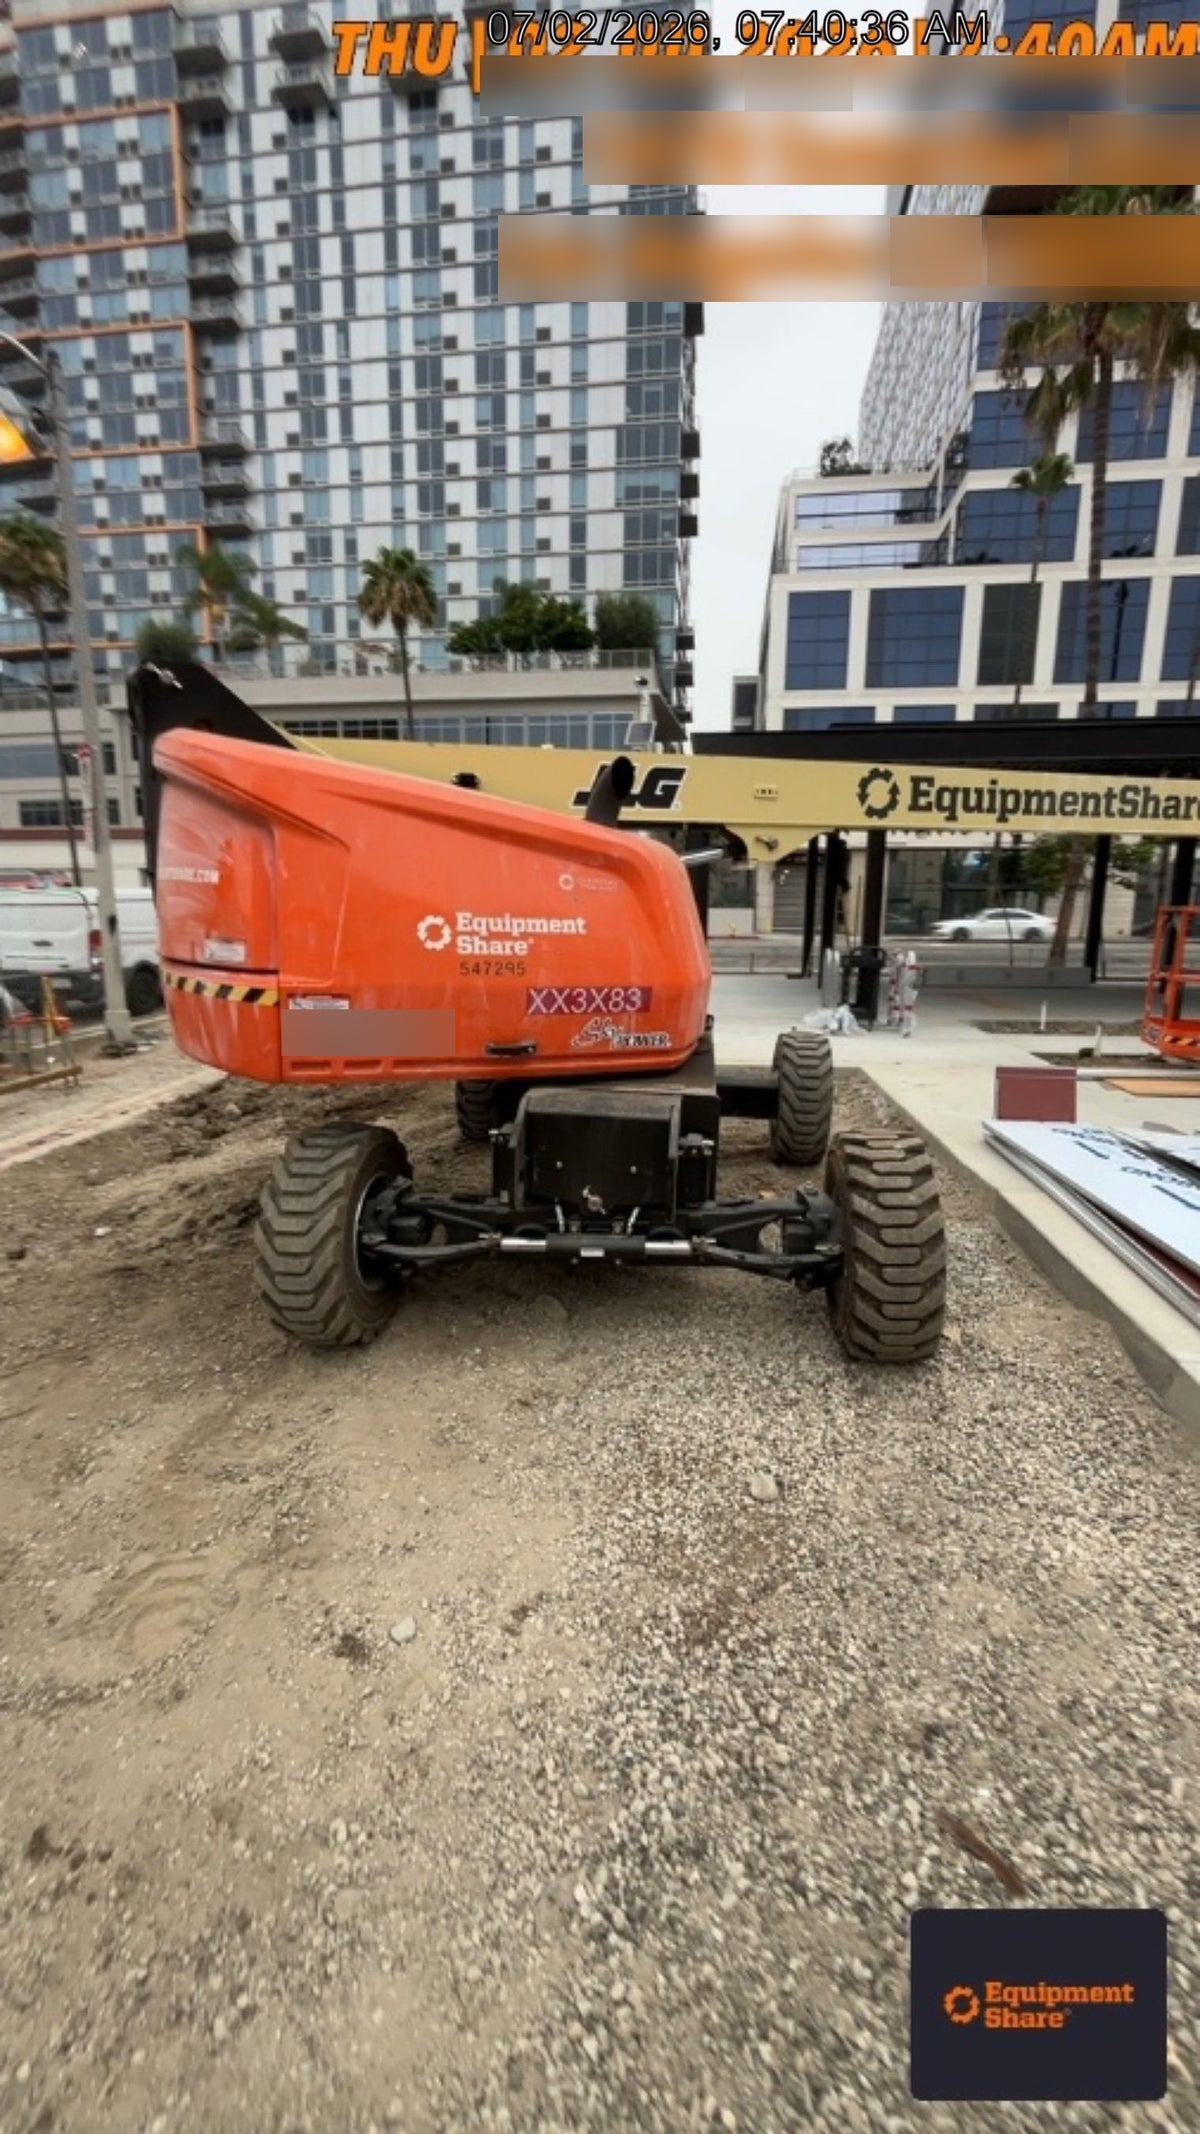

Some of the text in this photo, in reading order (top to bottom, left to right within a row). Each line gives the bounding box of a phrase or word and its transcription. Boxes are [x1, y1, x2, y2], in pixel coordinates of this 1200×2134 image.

[907, 774, 1200, 824] EquipmentShar
[455, 912, 588, 937] Equipment
[459, 960, 526, 977] 547295
[527, 987, 642, 1014] XX3X83
